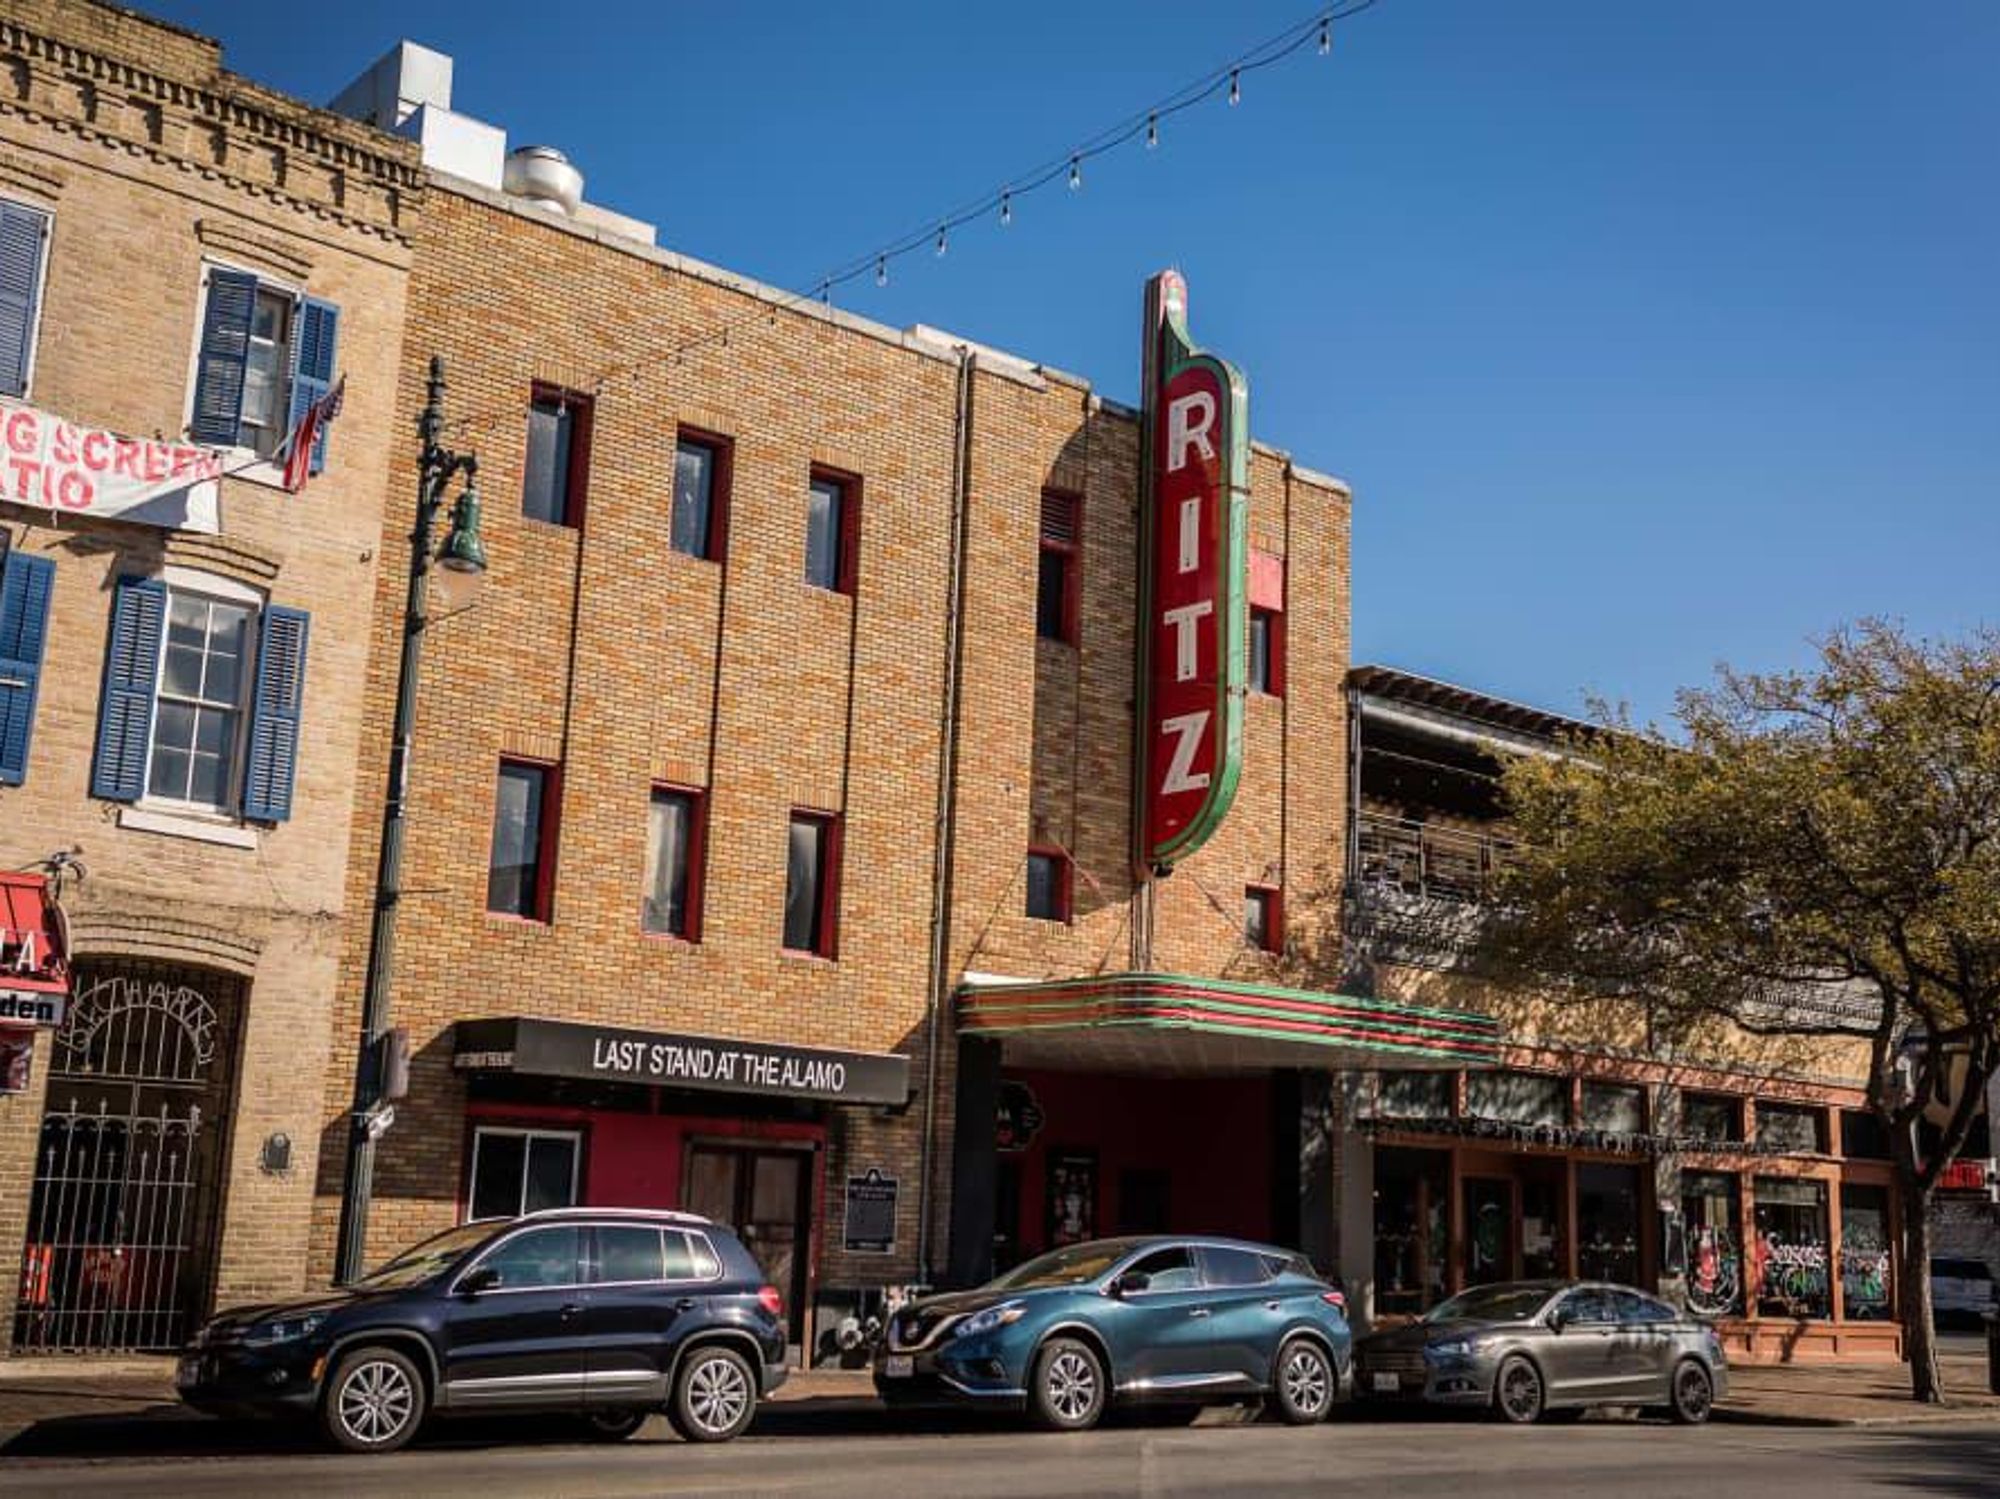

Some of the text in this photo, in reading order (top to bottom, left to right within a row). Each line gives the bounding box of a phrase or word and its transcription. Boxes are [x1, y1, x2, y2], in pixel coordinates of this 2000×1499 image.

[0, 405, 37, 454] G
[0, 456, 94, 510] TIO
[1161, 390, 1215, 796] RITZ
[593, 1038, 846, 1092] LAST STAND AT THE ALAMO
